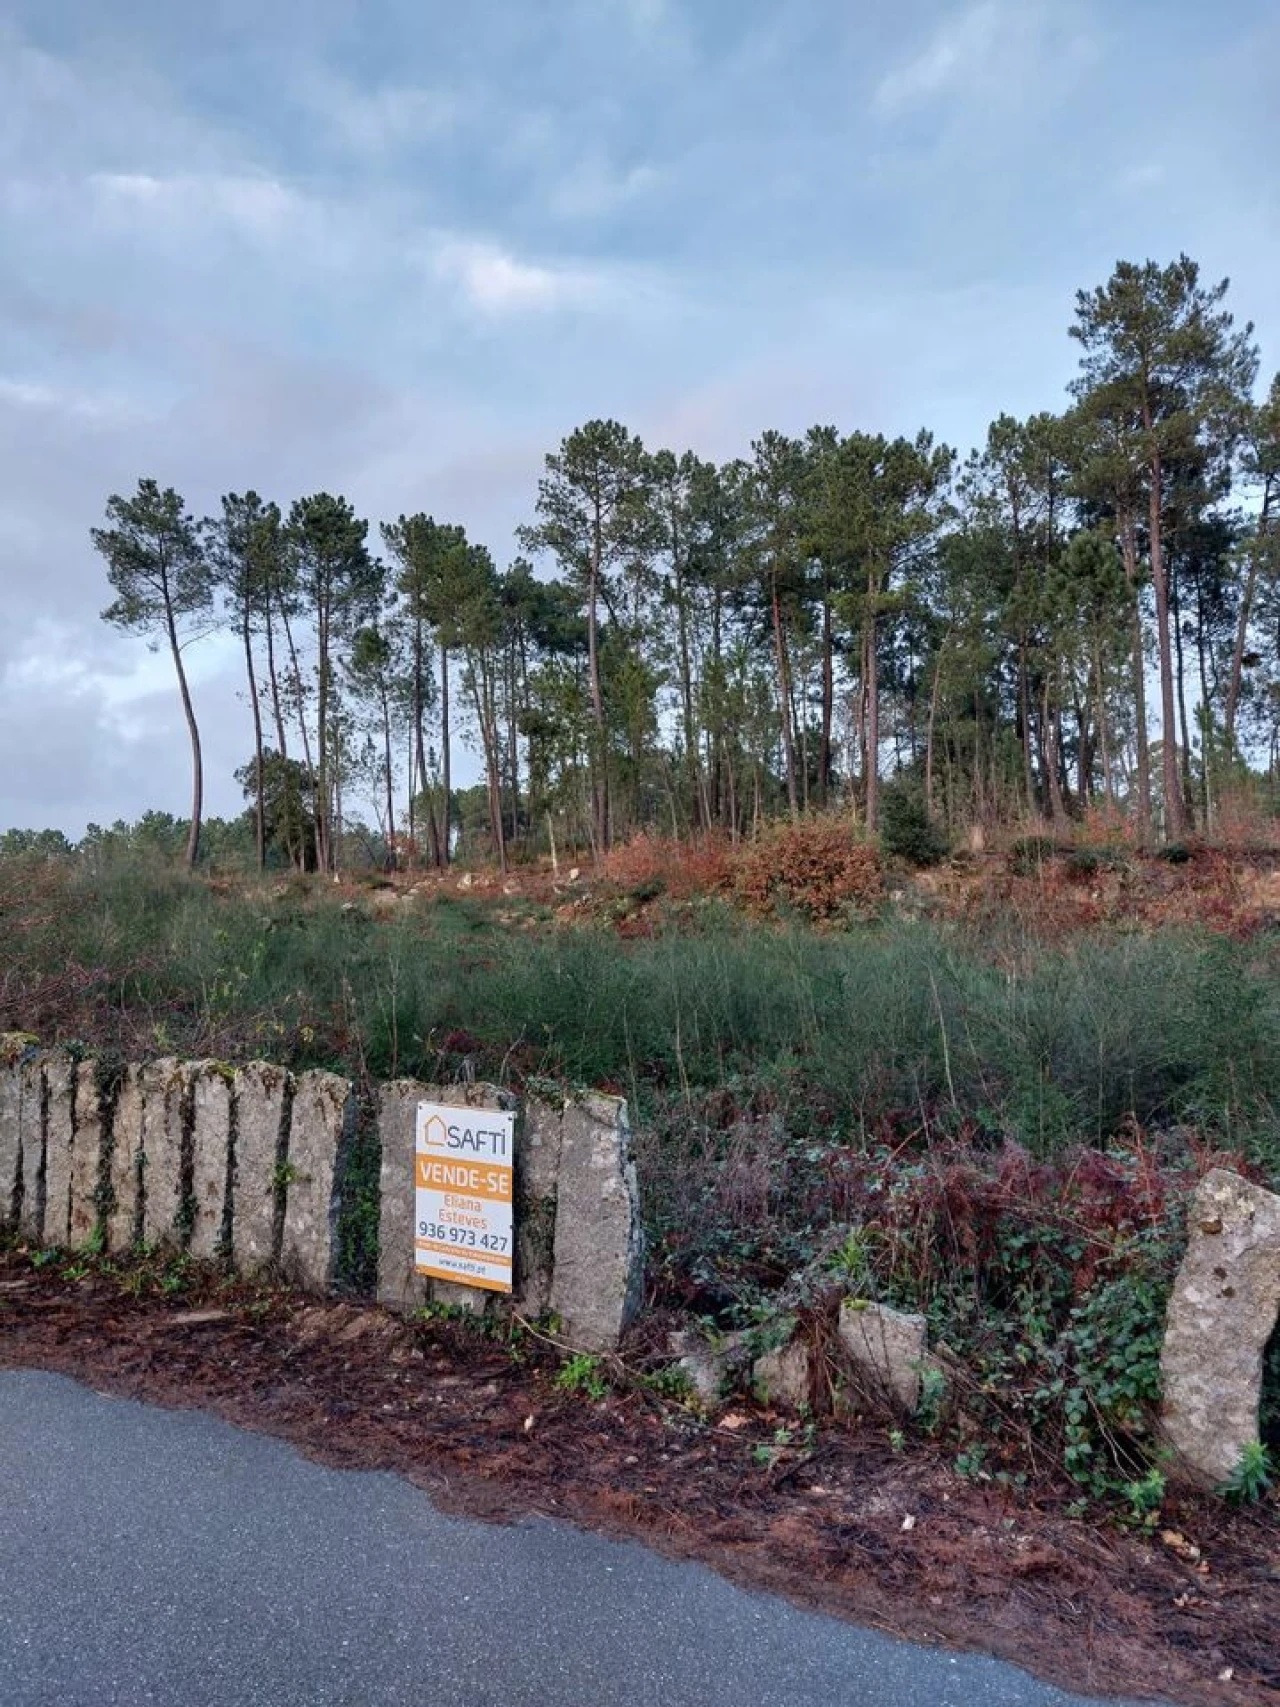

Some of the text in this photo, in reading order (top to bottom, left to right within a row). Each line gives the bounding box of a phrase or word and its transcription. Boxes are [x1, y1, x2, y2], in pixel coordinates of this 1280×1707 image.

[420, 1160, 509, 1194] VENDE-SE
[444, 1194, 483, 1212] Eliana
[438, 1208, 488, 1230] Esteves
[419, 1221, 508, 1251] 936 973 427
